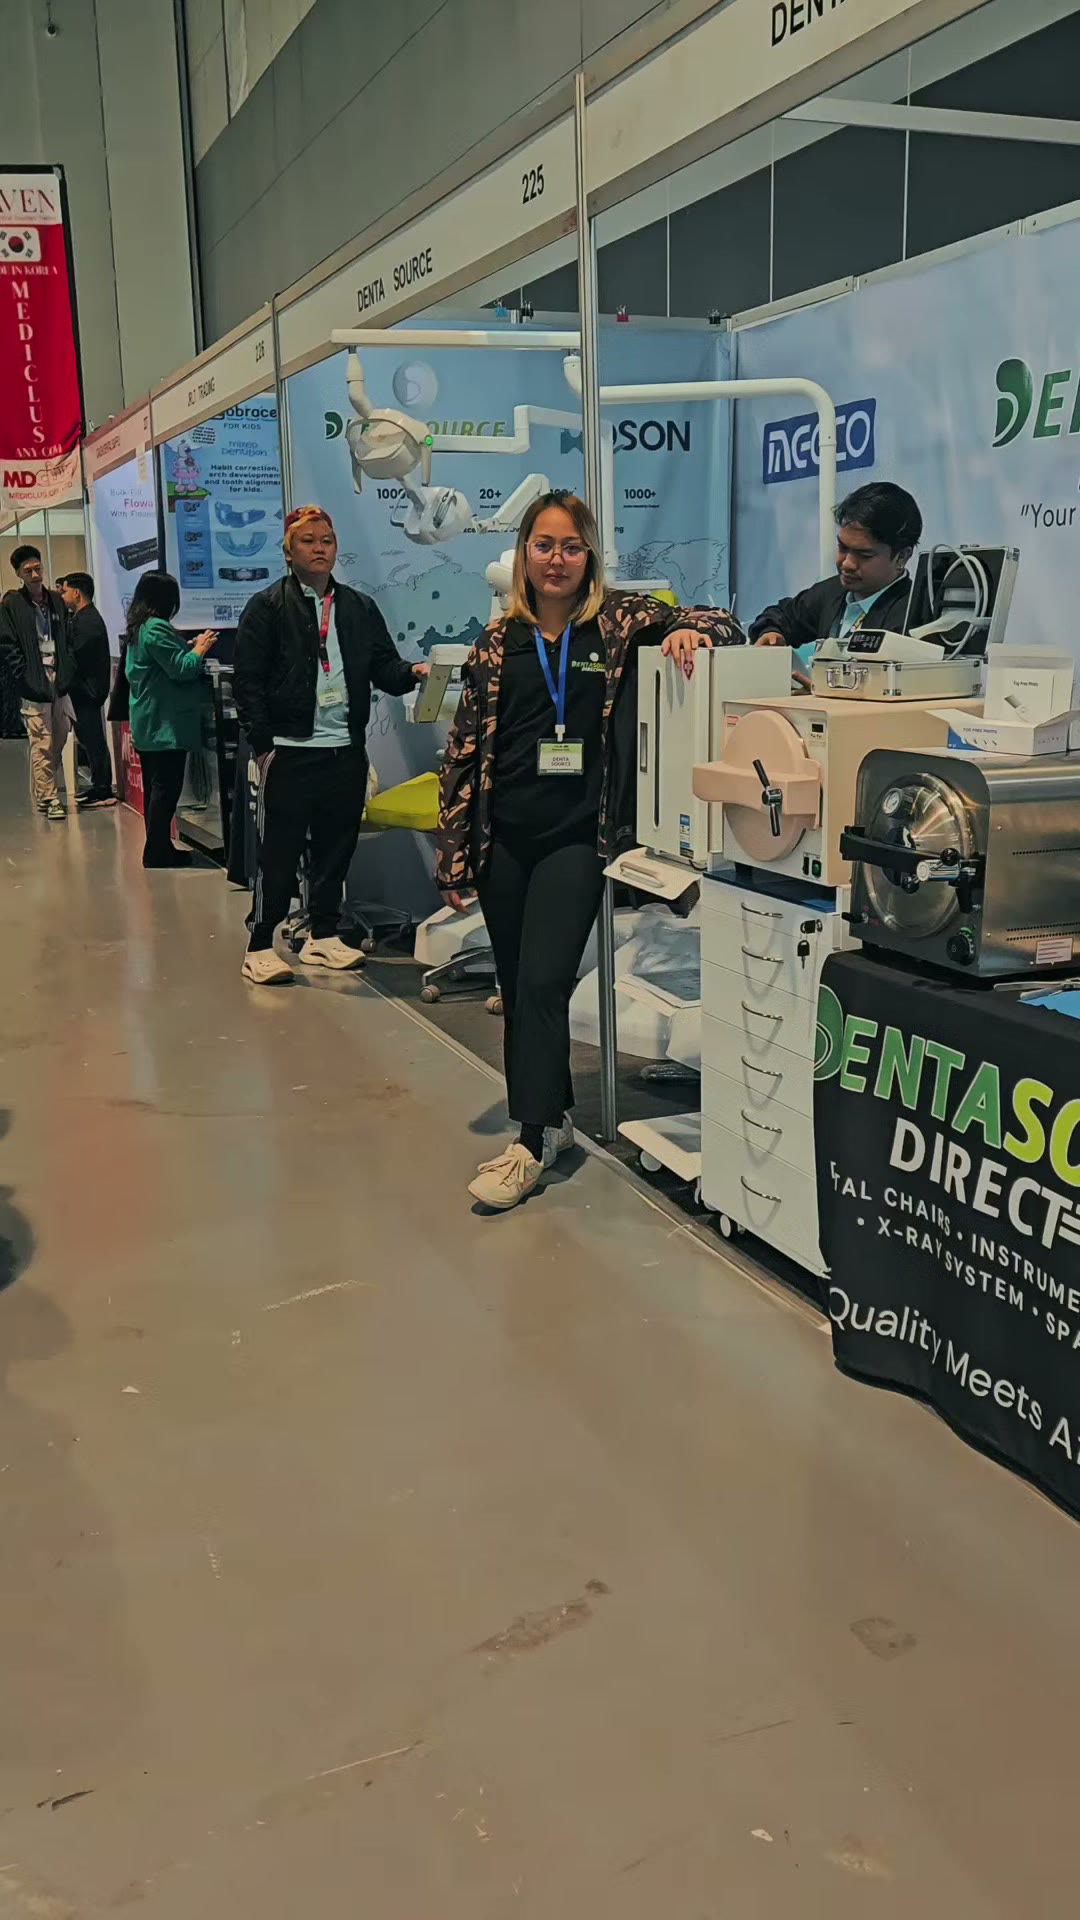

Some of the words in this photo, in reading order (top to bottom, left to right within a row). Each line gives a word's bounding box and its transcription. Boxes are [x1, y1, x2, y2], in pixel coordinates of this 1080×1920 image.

[0, 188, 56, 213] VEN
[522, 164, 544, 204] 225
[357, 277, 385, 312] DENTA
[393, 248, 433, 291] SOURCE
[12, 281, 45, 443] MEDICLUS
[4, 470, 37, 489] MD
[229, 472, 280, 480] developmen
[234, 464, 279, 472] correction,
[480, 488, 502, 500] 20+
[624, 488, 657, 500] 1000+
[889, 1117, 1073, 1249] DIRECT
[884, 1187, 951, 1237] CHAIRS
[878, 1216, 942, 1259] X-RAY
[945, 1251, 1024, 1311] SYSTEM
[829, 1287, 941, 1364] Quality
[946, 1340, 1043, 1430] Meets
